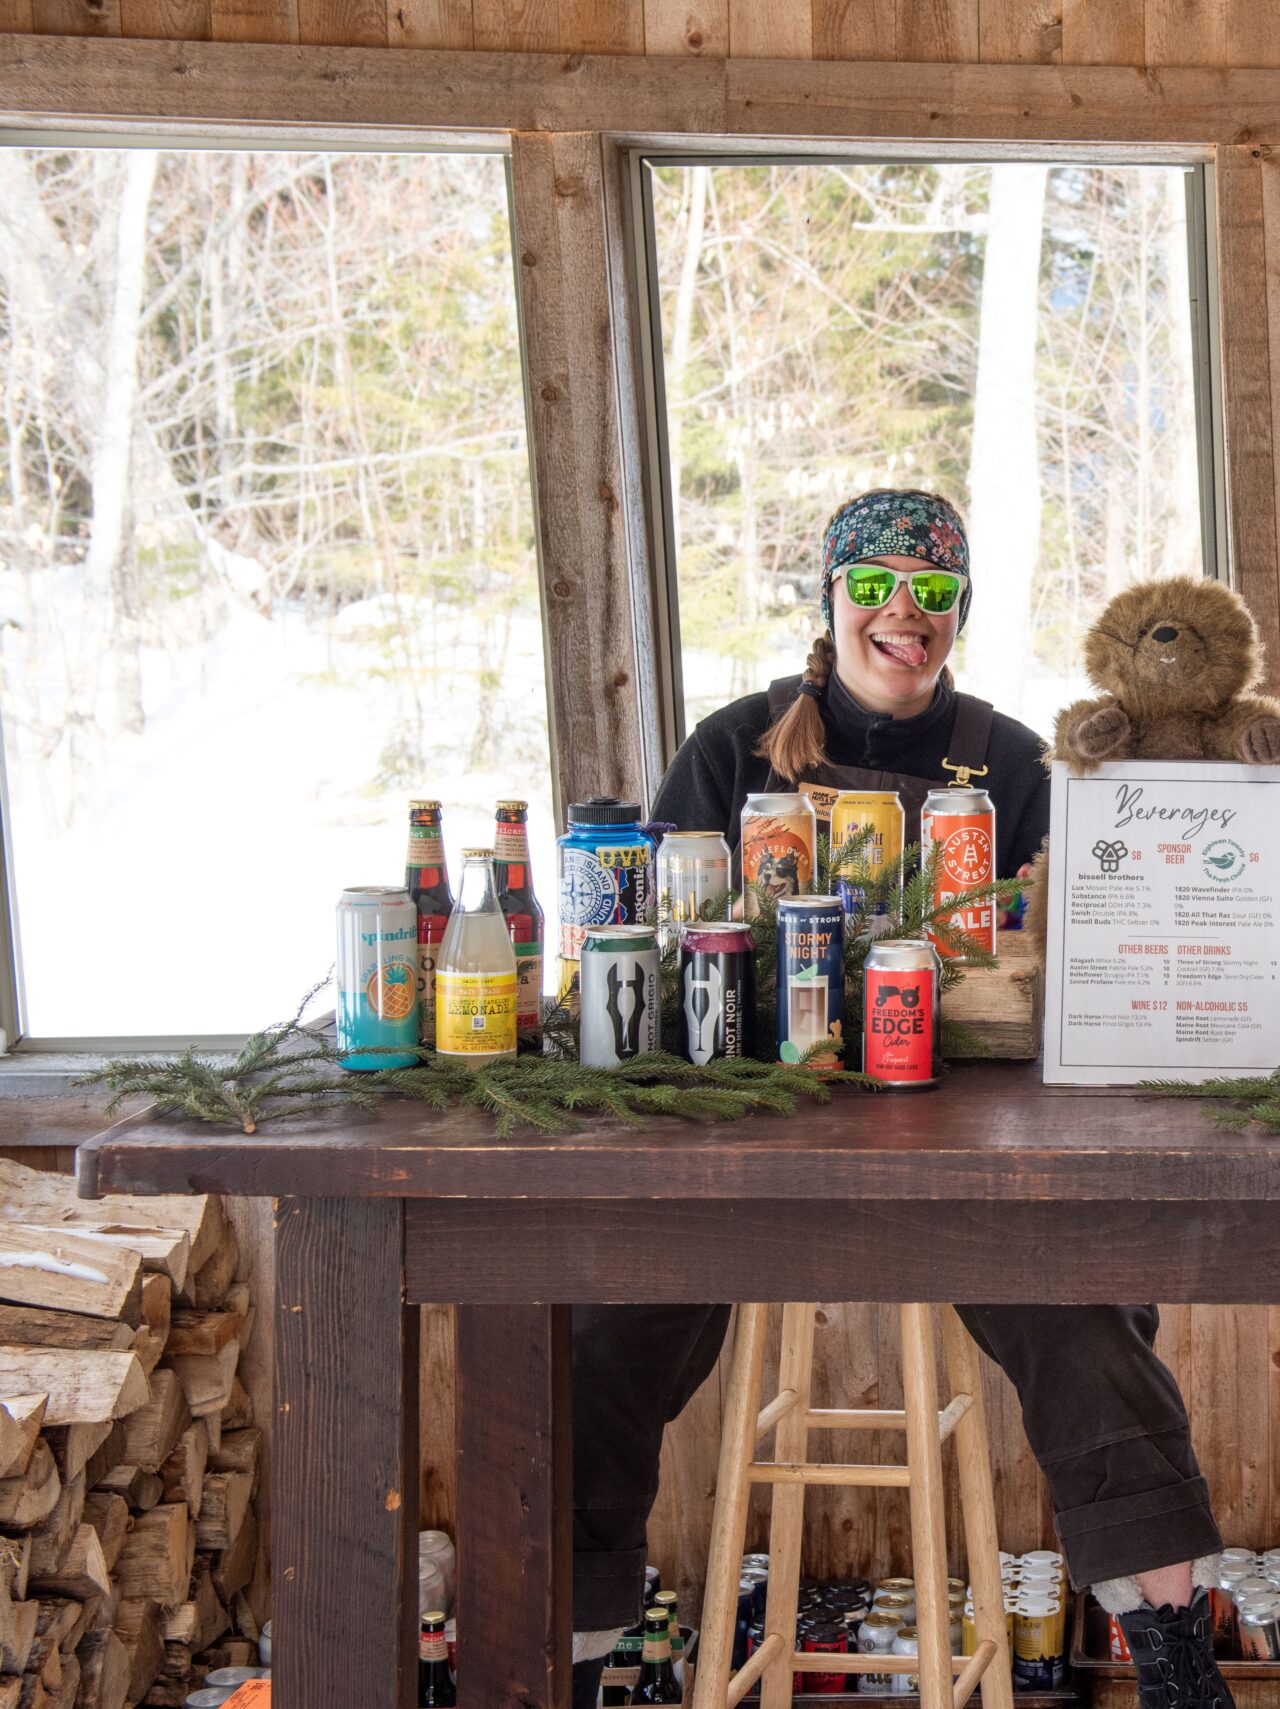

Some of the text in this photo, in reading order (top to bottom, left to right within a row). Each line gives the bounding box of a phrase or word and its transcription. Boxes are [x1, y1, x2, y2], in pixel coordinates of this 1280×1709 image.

[1114, 783, 1237, 840] Beverages
[831, 832, 884, 846] ALLSH
[947, 831, 990, 854] AUSTIN
[1157, 843, 1192, 854] SPONSOR
[598, 846, 650, 869] UVM
[749, 844, 810, 868] BELLEFLOWER
[1132, 851, 1141, 860] $8
[1165, 854, 1185, 864] BEER
[1250, 853, 1259, 862] $6
[583, 859, 611, 891] ISLAND
[948, 859, 990, 881] STREET
[1203, 868, 1213, 879] The
[1230, 864, 1246, 881] Choice
[587, 898, 612, 927] OUND
[809, 916, 841, 924] STRONG
[950, 910, 991, 930] ALE
[785, 932, 833, 945] STORMY
[789, 946, 828, 959] NIGHT
[1118, 944, 1168, 954] OTHER BEERS
[1177, 945, 1231, 955] OTHER DRINKS
[361, 954, 404, 984] SPARLING
[448, 1004, 510, 1015] LEMONADE
[1132, 1000, 1167, 1010] WINE $12
[1177, 1001, 1248, 1011] NON-ALCOHOLIC $5
[647, 973, 656, 1052] NOT GRIGIO
[872, 1008, 925, 1017] FREEDOM'S
[725, 989, 736, 1058] INOT NOIR
[871, 1018, 925, 1034] EDGE
[882, 1035, 910, 1048] Cider
